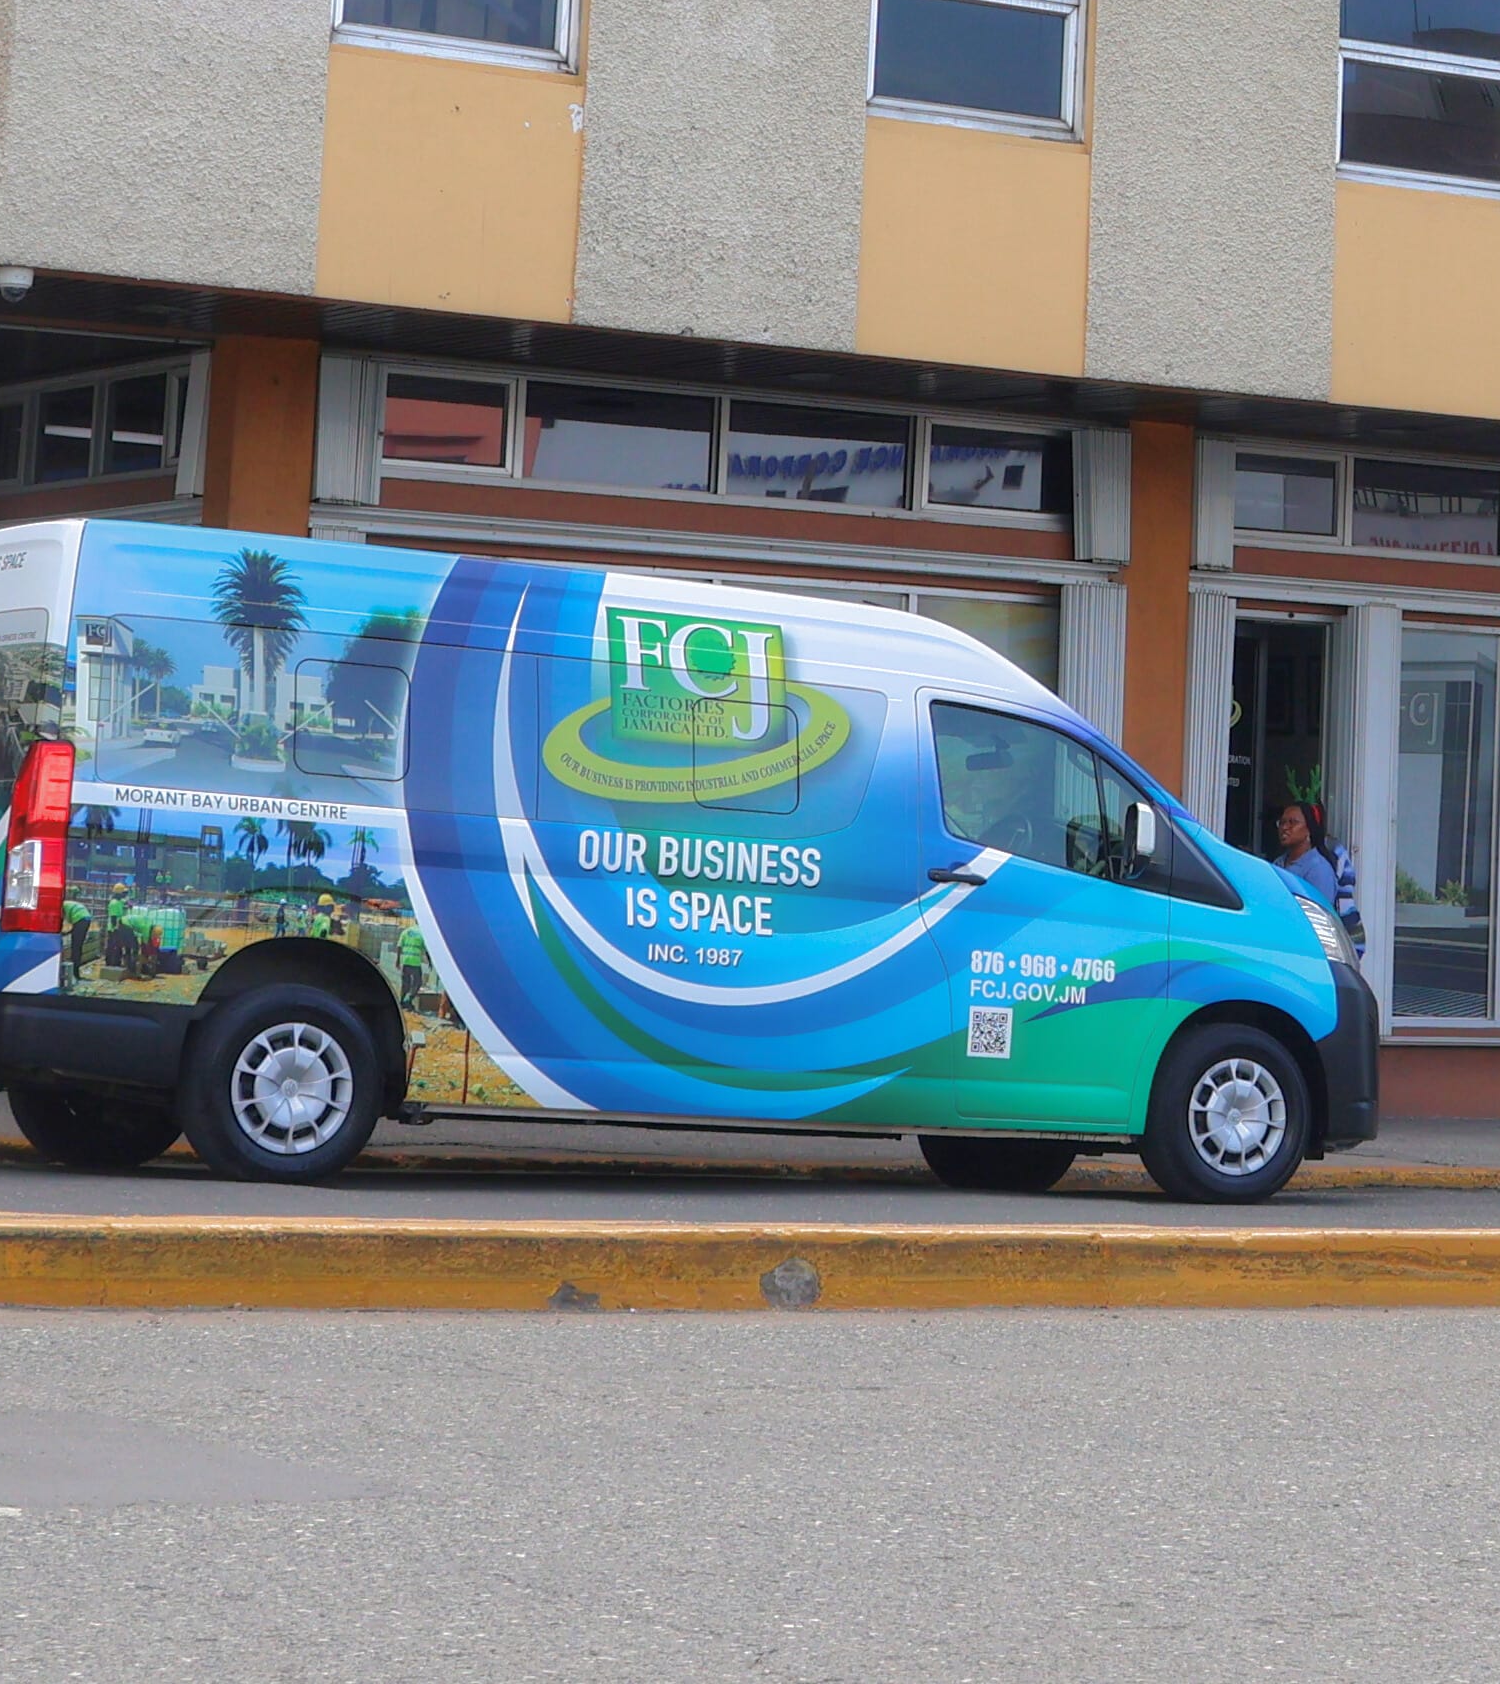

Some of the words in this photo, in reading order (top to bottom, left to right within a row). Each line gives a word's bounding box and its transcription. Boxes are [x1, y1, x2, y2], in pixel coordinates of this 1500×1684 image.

[615, 615, 774, 742] FCJ
[622, 692, 725, 716] FACTORIES
[622, 707, 698, 723] CORPORATION
[708, 715, 725, 726] OF
[622, 717, 692, 735] JAMAICA
[695, 724, 728, 740] LTD.
[1400, 692, 1442, 747] CJ
[560, 752, 580, 773] OUR
[580, 766, 623, 789] BUSINESS
[625, 779, 634, 790] IS
[635, 779, 685, 793] PROVIDING
[686, 773, 740, 792] INDUSTRIAL
[741, 770, 760, 784] AND
[759, 743, 819, 779] COMMERCIAL
[814, 720, 837, 749] SPACE
[115, 787, 188, 806] MORANT
[192, 793, 224, 810] BAY
[227, 796, 284, 815] URBAN
[287, 802, 348, 820] CENTRE
[578, 829, 647, 874] OUR
[657, 835, 822, 888] BUSINESS
[625, 887, 657, 928] IS
[668, 890, 773, 937] SPACE
[647, 943, 689, 963] INC.
[695, 947, 743, 967] 1987
[1071, 958, 1116, 983] 4766
[970, 979, 1087, 1005] FCJ.GOV.JM
